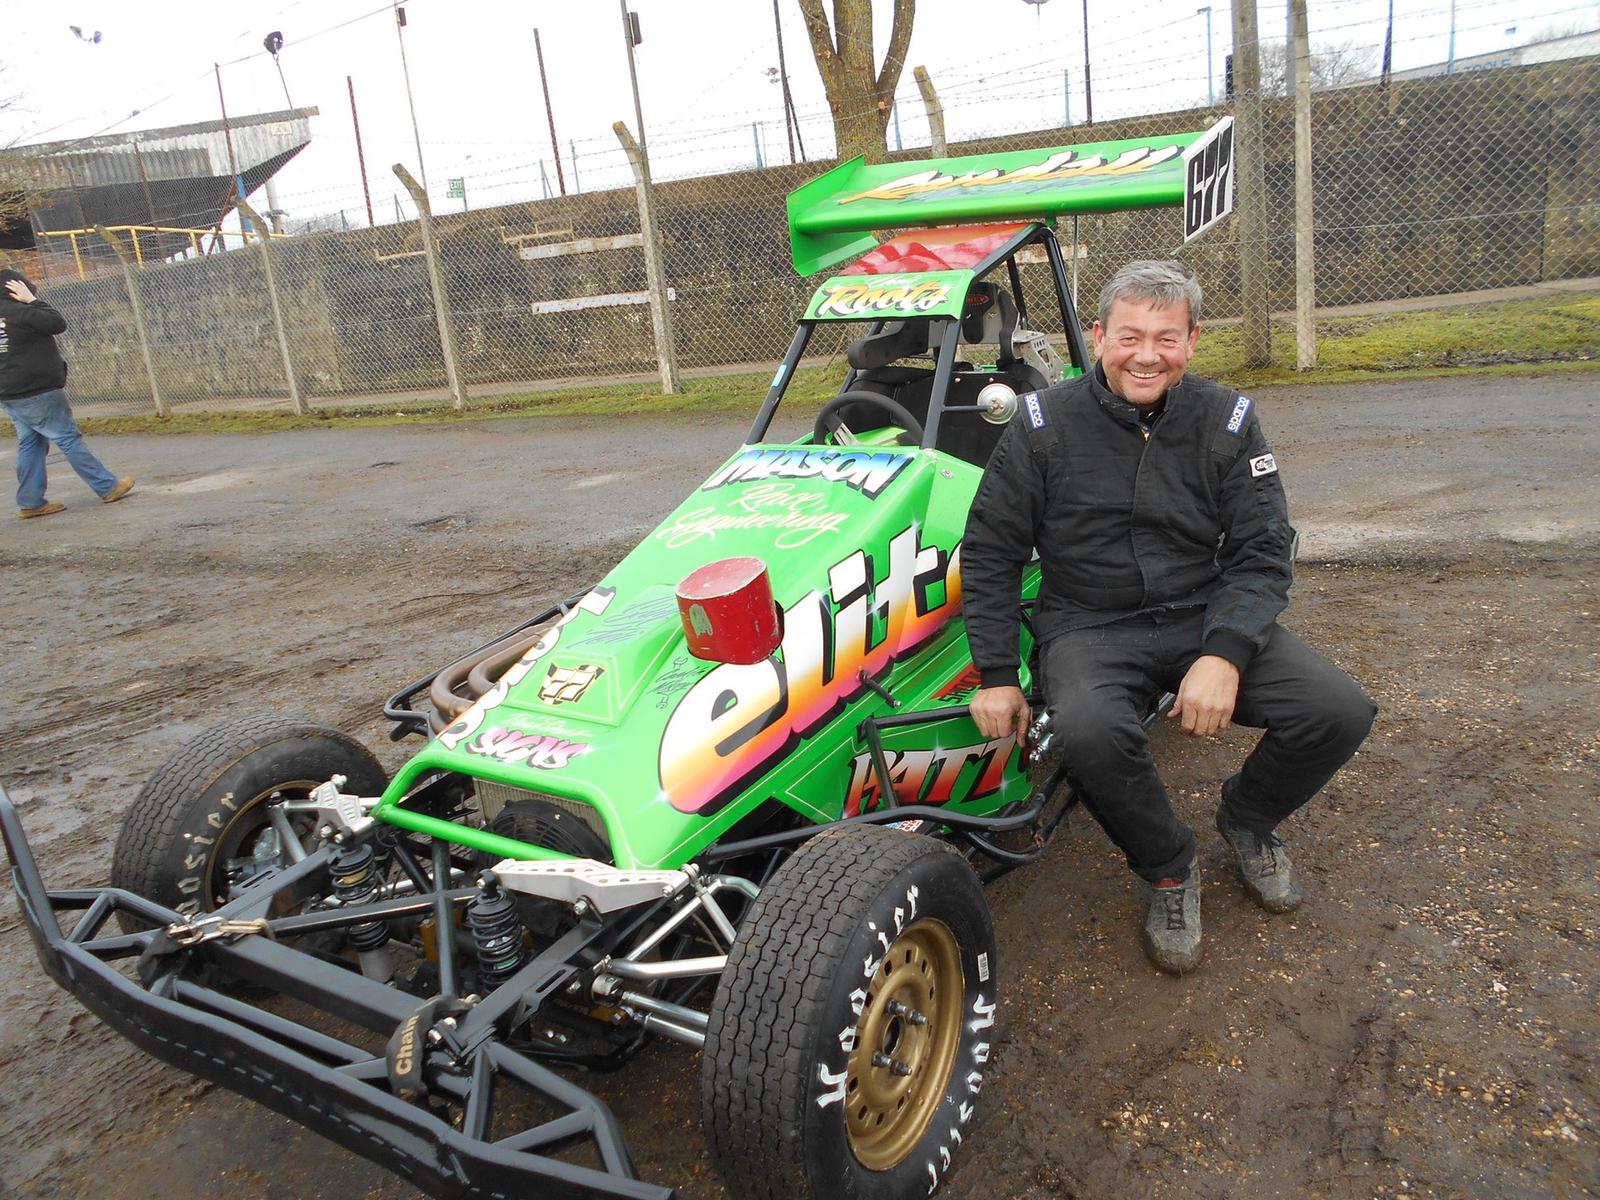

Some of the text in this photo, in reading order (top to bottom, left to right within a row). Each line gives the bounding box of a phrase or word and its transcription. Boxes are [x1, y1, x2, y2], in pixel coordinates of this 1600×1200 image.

[1186, 119, 1232, 237] 677
[815, 279, 950, 318] Roots
[1228, 396, 1247, 431] sparco
[702, 450, 917, 500] MASON
